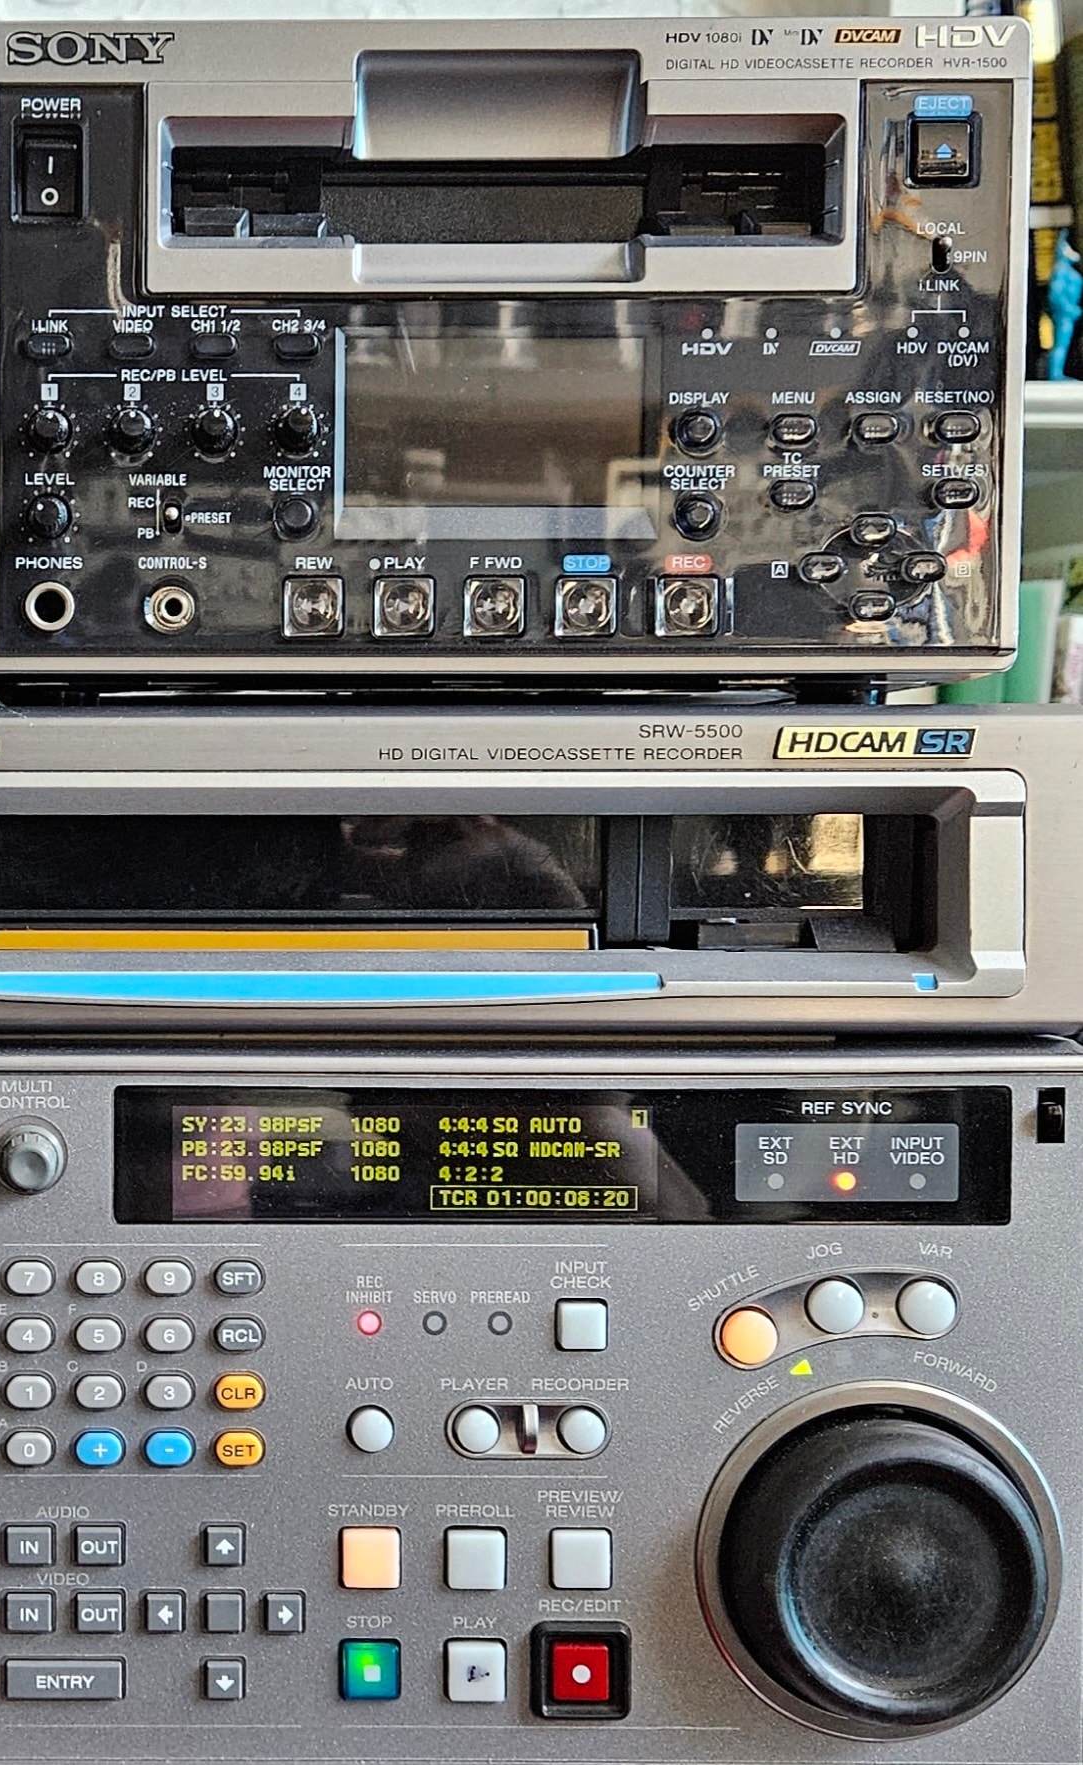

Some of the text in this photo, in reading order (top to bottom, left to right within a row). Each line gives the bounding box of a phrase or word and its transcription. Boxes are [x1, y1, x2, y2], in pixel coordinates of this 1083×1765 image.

[665, 33, 742, 43] HDV 1080i
[837, 30, 899, 43] DVCAM
[915, 25, 1016, 47] HDV
[6, 31, 174, 66] SONY
[666, 57, 1007, 70] DIGITAL HD VIDEOCASSETTE RECORDER HVR-1500
[21, 97, 81, 112] POWER
[918, 97, 969, 109] EJECT
[916, 222, 965, 235] LOCAL
[953, 250, 987, 264] 9PIN
[122, 306, 227, 318] INPUT SELECT
[112, 320, 153, 332] VIDEO
[191, 320, 240, 331] CH1 1/2
[272, 320, 325, 331] CH2 3/4
[937, 342, 989, 354] DVCAM
[121, 369, 227, 381] REC/PB LEVEL
[669, 392, 729, 404] DISPLAY
[772, 392, 815, 404] MENU
[845, 391, 901, 404] ASSIGN
[915, 391, 994, 404] RESET(NO)
[783, 452, 801, 464] TC
[263, 467, 331, 478] MONITOR
[664, 466, 735, 478] COUNTER
[764, 466, 820, 478] PRESET
[922, 464, 989, 477] SET(YES)
[25, 474, 75, 486] LEVEL
[129, 474, 186, 486] VARIABLE
[269, 479, 324, 491] SELECT
[670, 478, 727, 490] SELECT
[191, 512, 231, 524] PRESET
[15, 557, 83, 570] PHONES
[138, 557, 207, 570] CONTROL-S
[296, 557, 333, 570] REW
[384, 557, 426, 570] PLAY
[470, 557, 522, 568] F FWD
[565, 556, 608, 570] STOP
[671, 556, 705, 568] REC
[639, 725, 743, 739] SRW-5500
[789, 730, 971, 754] HDCAM SR
[379, 747, 743, 761] HD DIGITAL VIDEOCASSETTE RECORDER
[1, 1080, 53, 1093] MULTI
[801, 1102, 893, 1115] REF SYNC
[351, 1117, 400, 1133] 1080
[530, 1117, 581, 1133] AUTO
[758, 1137, 793, 1149] EXT
[829, 1137, 864, 1149] EXT
[891, 1137, 944, 1149] INPUT
[763, 1152, 787, 1165] SD
[833, 1152, 859, 1165] HD
[890, 1152, 945, 1165] VIDEO
[440, 1191, 477, 1205] TCR
[805, 1242, 843, 1260] JOG
[918, 1242, 953, 1260] VAR
[555, 1261, 608, 1274] INPUT
[222, 1272, 255, 1285] SFT
[550, 1276, 612, 1289] CHECK
[687, 1264, 759, 1313] SHUTTLE
[470, 1290, 530, 1303] PREREAD
[222, 1329, 258, 1343] RCL
[913, 1351, 999, 1394] FORWARD
[345, 1377, 393, 1391] AUTO
[441, 1378, 509, 1391] PLAYER
[532, 1378, 629, 1391] RECORDER
[221, 1388, 255, 1399] CLR
[713, 1375, 781, 1435] REVERSE
[223, 1445, 255, 1457] SET
[538, 1490, 623, 1503] PREVIEW/
[328, 1504, 409, 1517] STANDBY
[436, 1504, 515, 1517] PREROLL
[545, 1505, 615, 1517] REVIEW
[538, 1600, 621, 1612] REC/EDIT
[346, 1616, 392, 1628] STOP
[453, 1616, 498, 1629] PLAY
[35, 1675, 95, 1689] ENTRY
